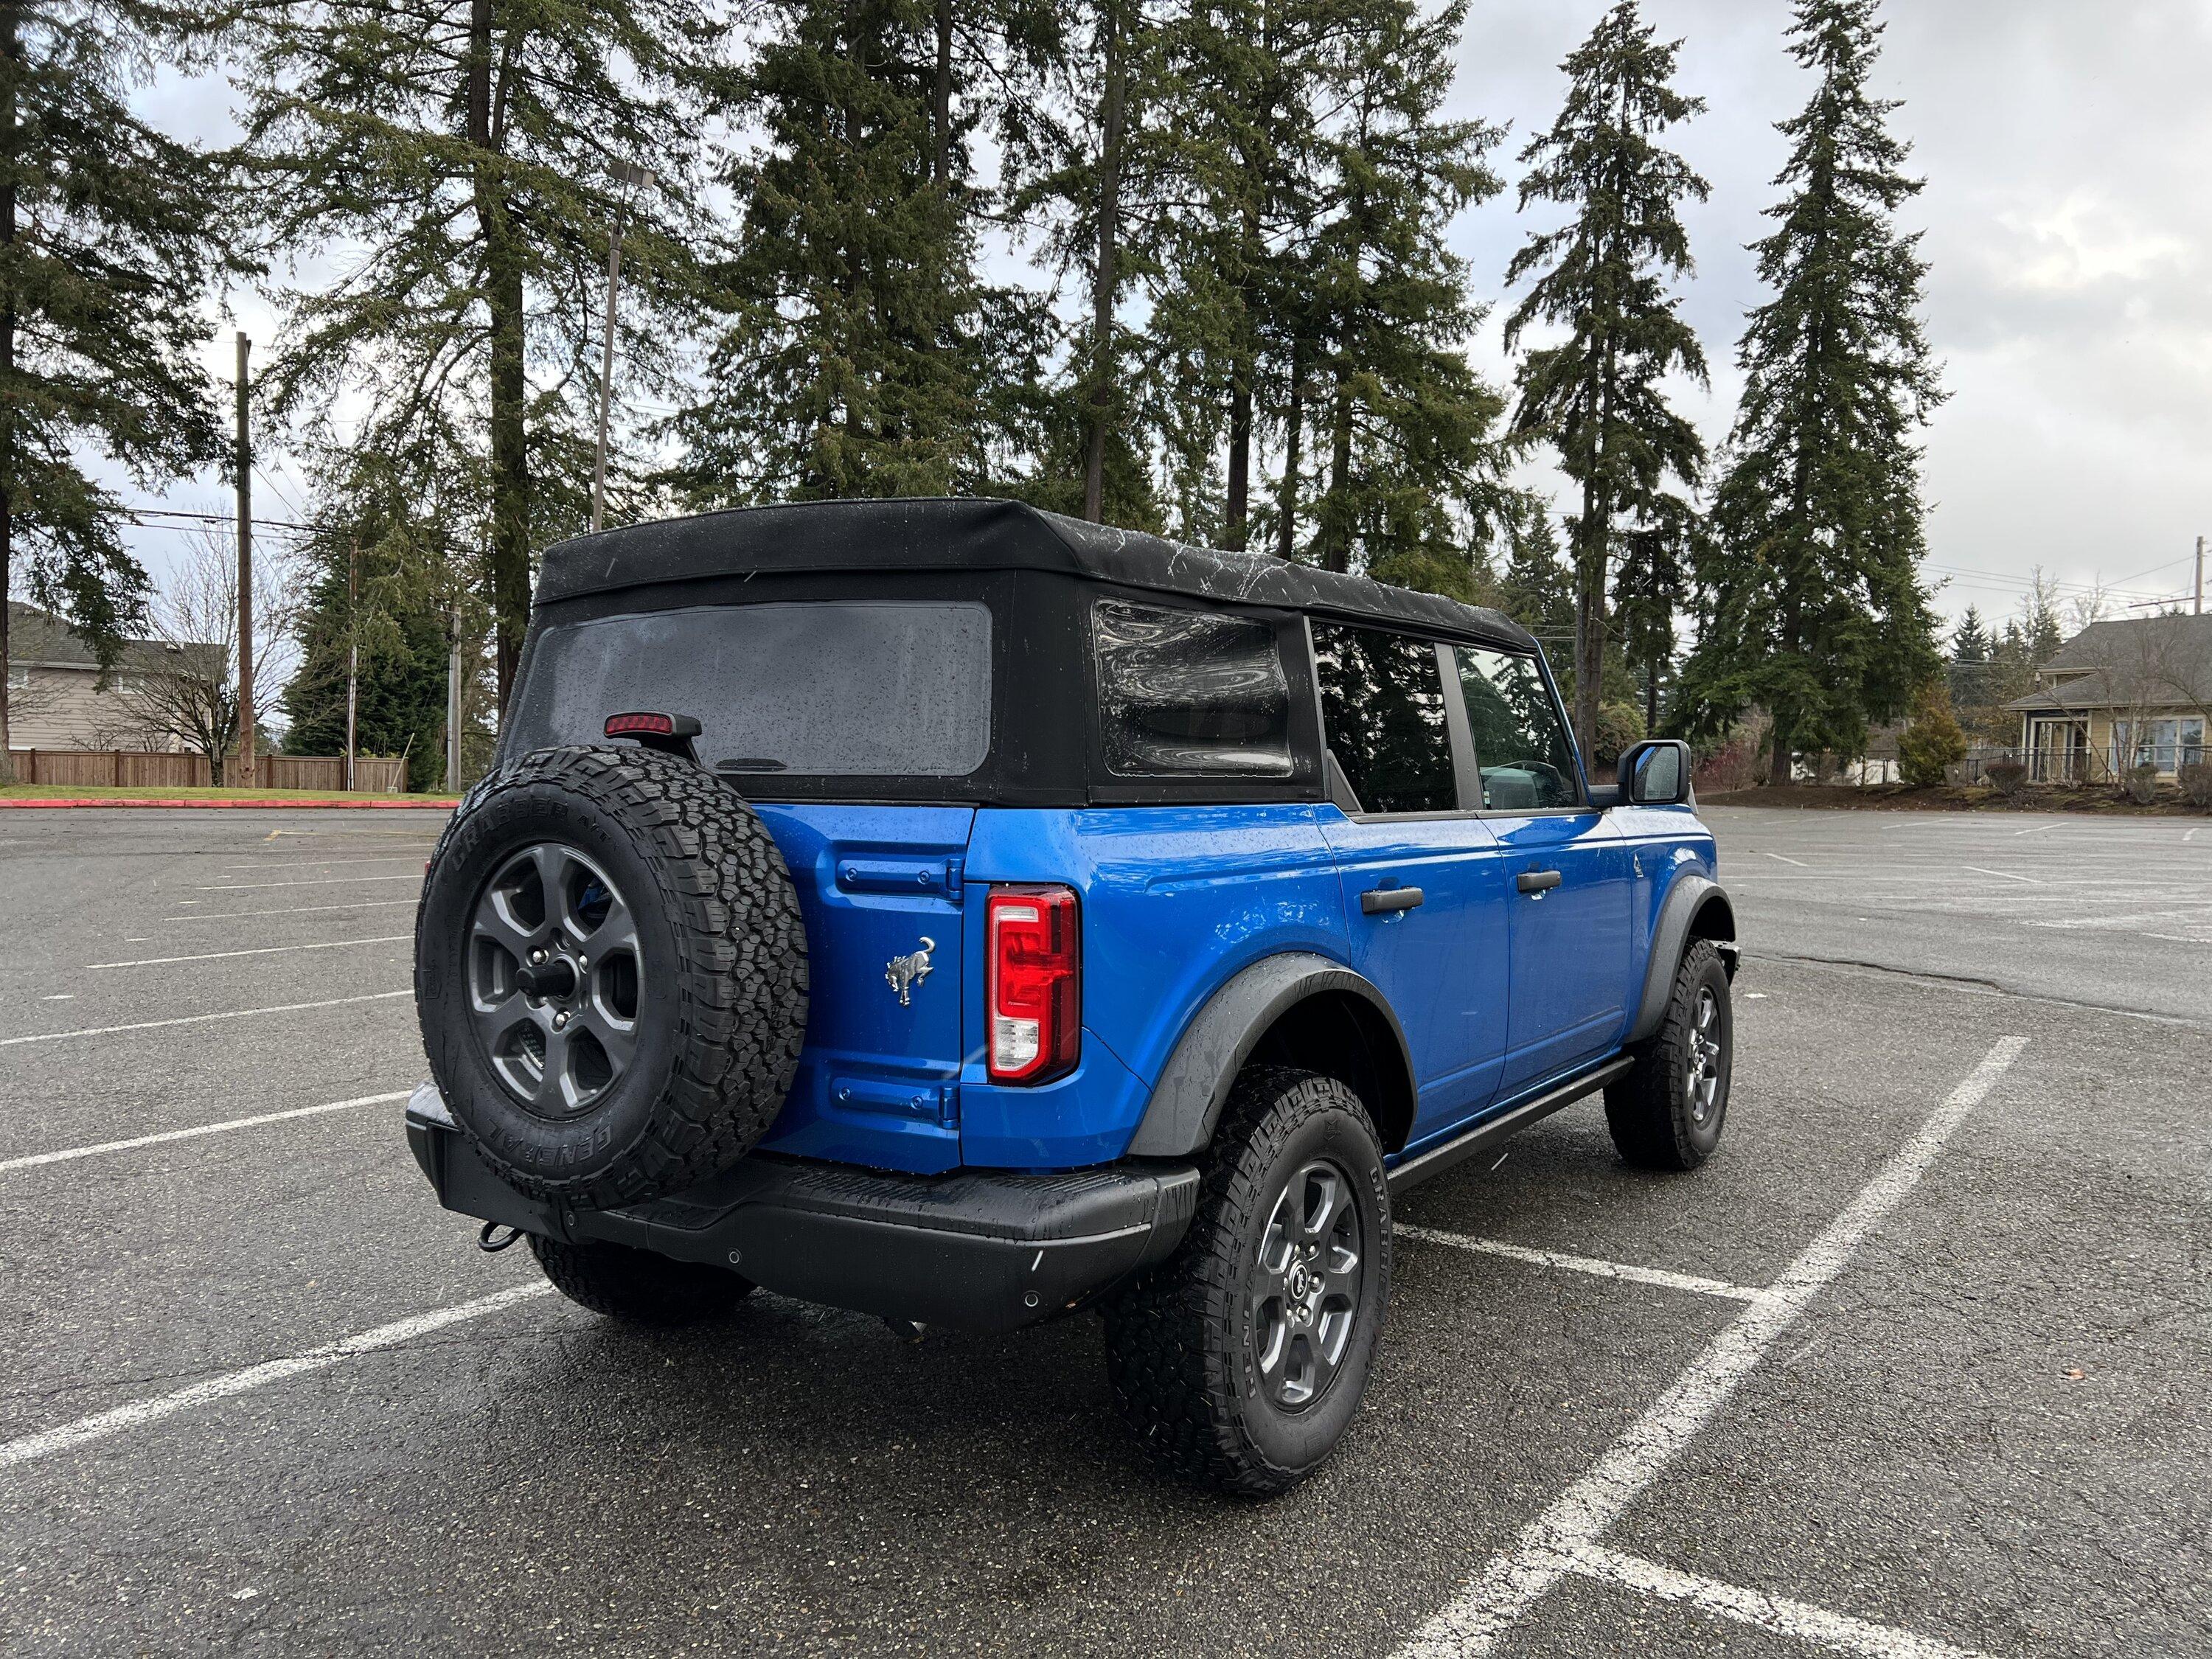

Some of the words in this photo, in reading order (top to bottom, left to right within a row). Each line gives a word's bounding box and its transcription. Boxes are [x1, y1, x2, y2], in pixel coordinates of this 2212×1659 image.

[451, 794, 570, 872] GRABBER
[486, 1116, 612, 1169] GENERAL
[1368, 1166, 1388, 1322] GRABBER
